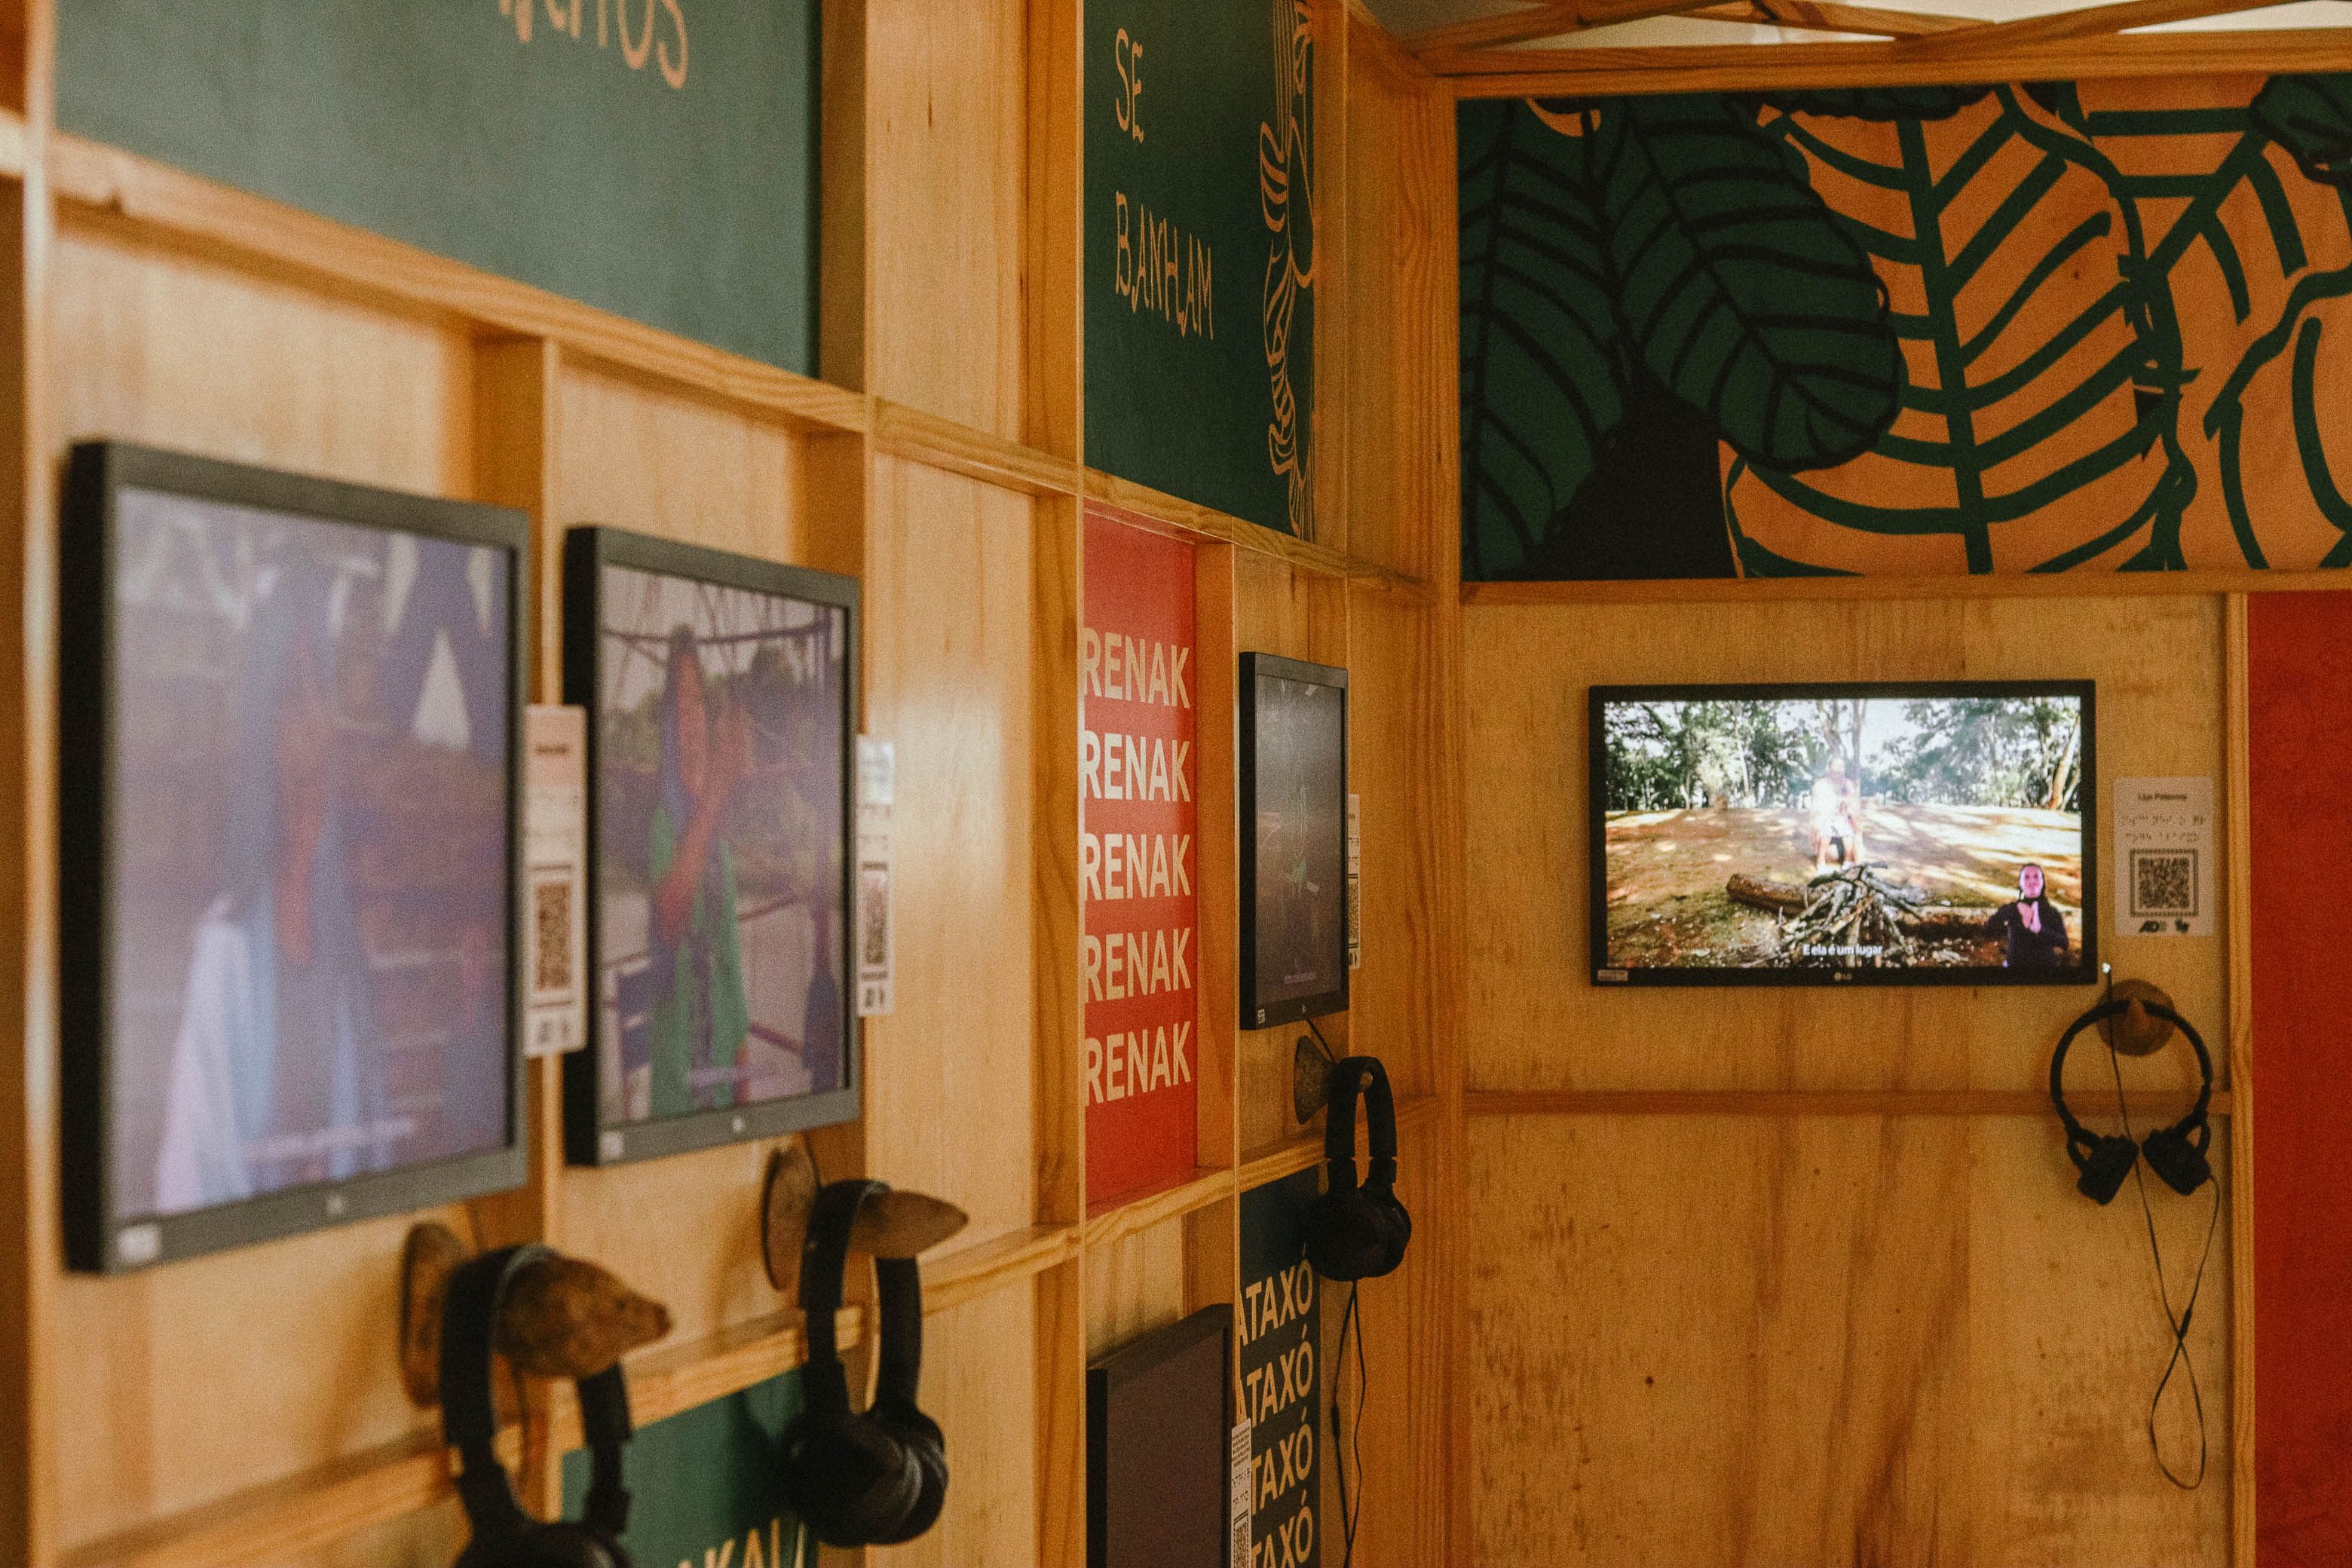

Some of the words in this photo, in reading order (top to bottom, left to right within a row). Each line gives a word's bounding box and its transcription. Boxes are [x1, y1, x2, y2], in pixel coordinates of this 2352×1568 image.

[1115, 27, 1144, 143] SE
[1116, 190, 1214, 340] BANHAM
[1802, 943, 1811, 956] E
[1836, 945, 1854, 956] um
[1855, 942, 1883, 958] lugar
